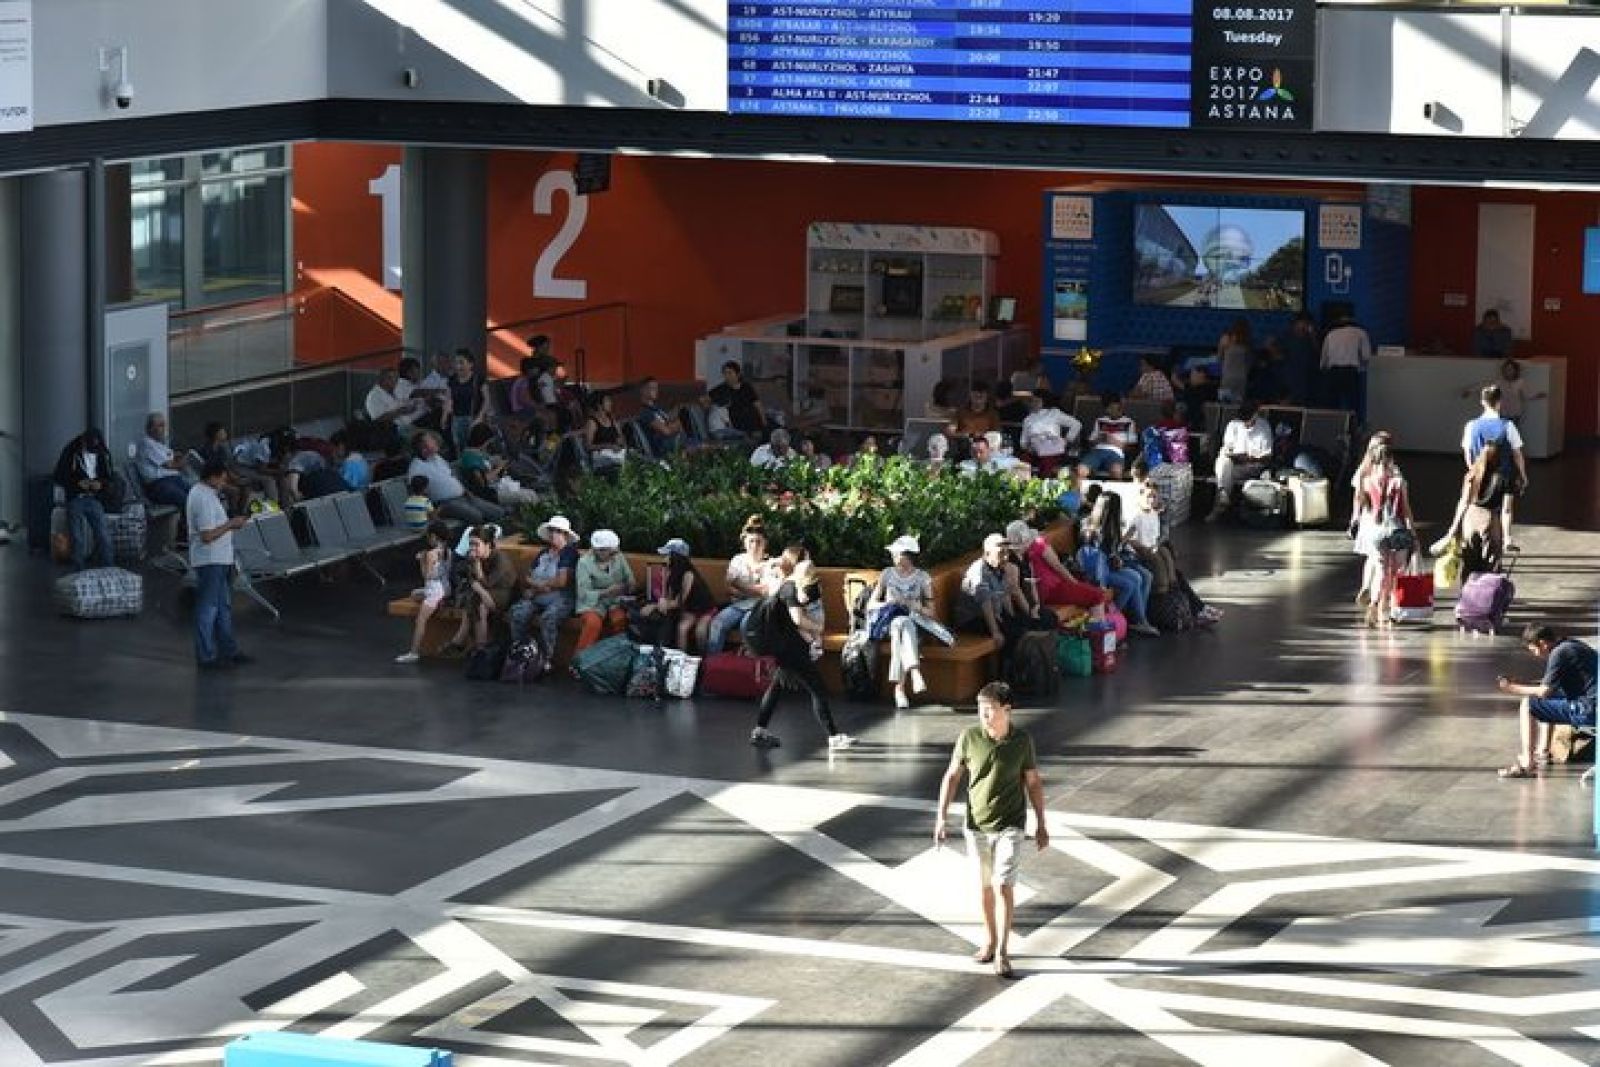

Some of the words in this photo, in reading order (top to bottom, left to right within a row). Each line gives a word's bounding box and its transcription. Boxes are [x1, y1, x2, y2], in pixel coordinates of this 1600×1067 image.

[1213, 8, 1294, 20] 08.08.2017
[1223, 30, 1283, 47] Tuesday
[1026, 68, 1059, 79] 21:47
[1210, 66, 1263, 82] EXPO
[1210, 85, 1259, 101] 2017
[1208, 104, 1295, 121] ASTANA
[368, 164, 402, 289] 1
[533, 169, 589, 299] 2
